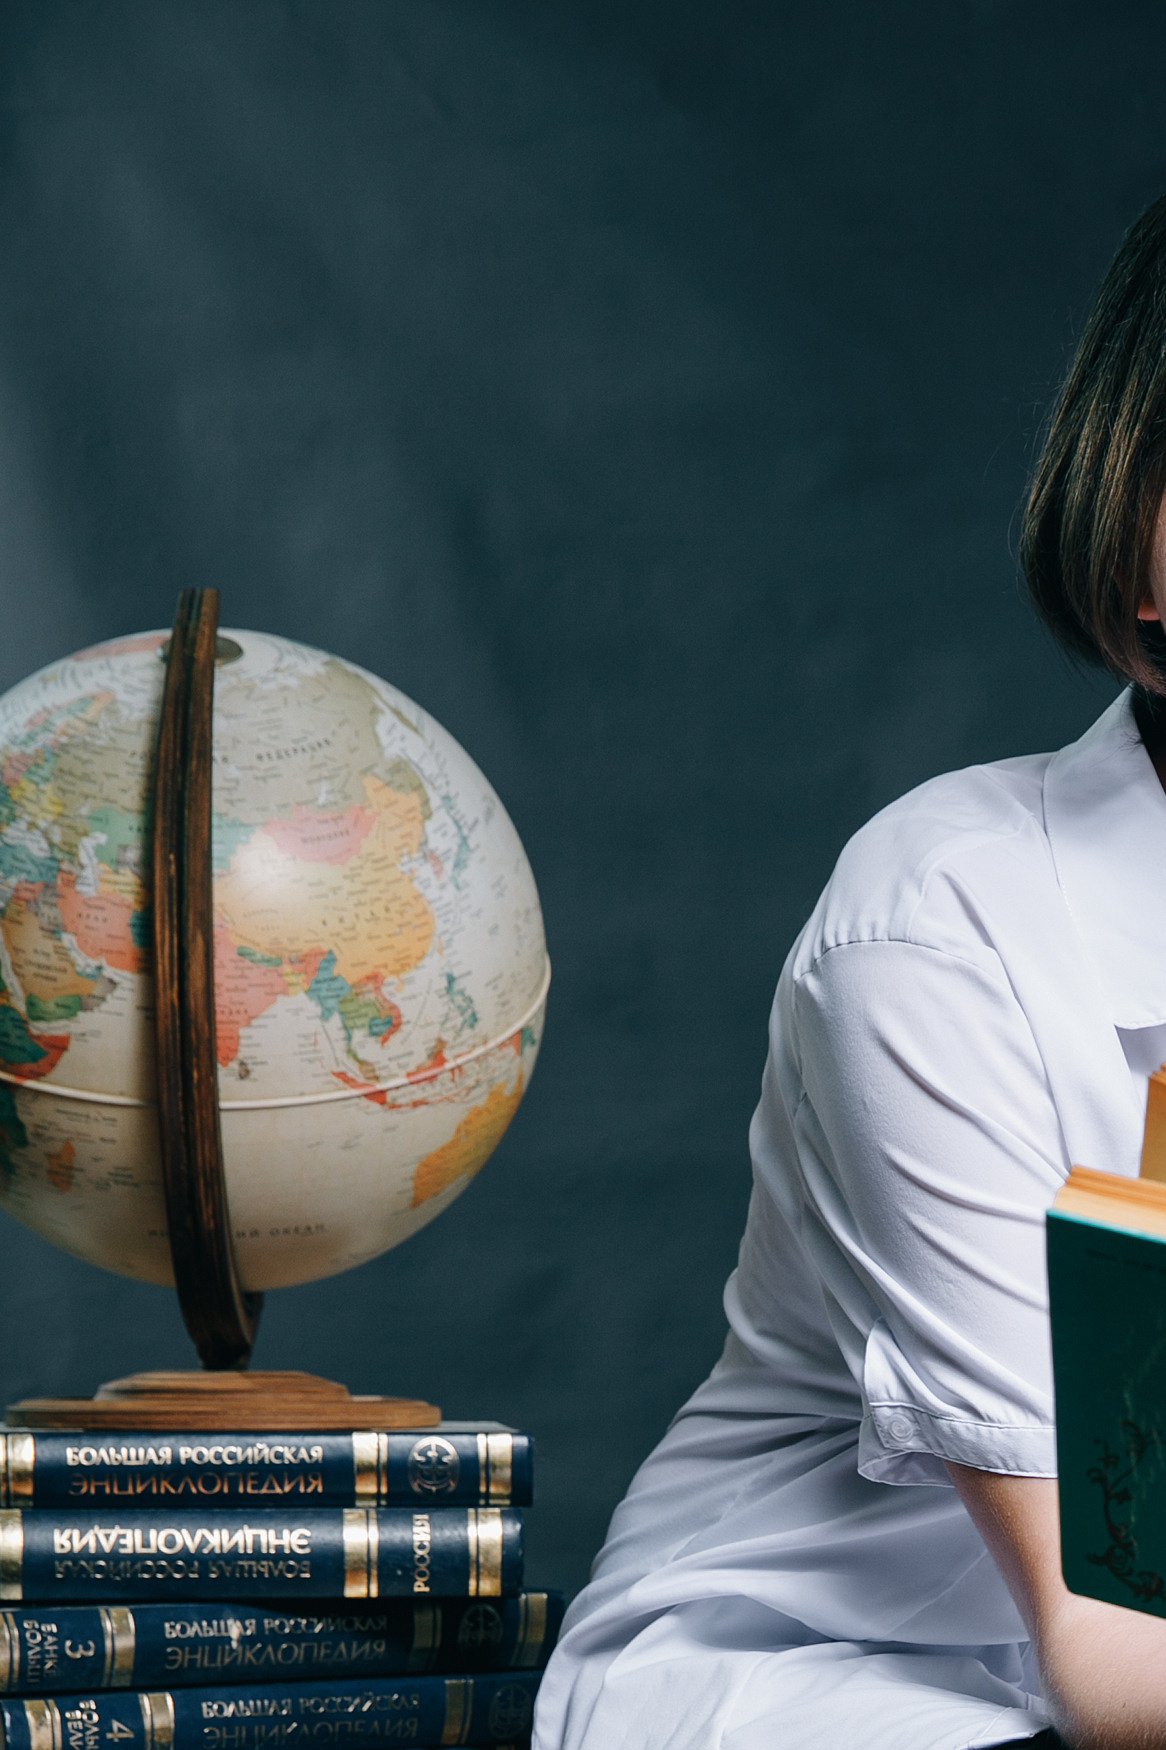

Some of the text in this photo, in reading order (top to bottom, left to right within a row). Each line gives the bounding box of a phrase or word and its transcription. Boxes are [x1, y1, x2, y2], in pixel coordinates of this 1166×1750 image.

[65, 1441, 324, 1467] БОЛЬШАЯ РОССИЙСКАЯ
[68, 1470, 324, 1496] ЭНЦИКЛОПЕДИЯ
[53, 1524, 312, 1554] ЭНЦИКЛОПЕДИЯ
[54, 1559, 312, 1581] БОЛЬШАЯ РОССИЙСКАЯ
[163, 1617, 257, 1640] БОЛЬШАЯ
[64, 1639, 96, 1660] 3
[164, 1639, 387, 1671] ЭНЦИКЛОПЕДИЯ
[200, 1690, 420, 1719] БОЛЬШАЯ РОССИЙСКАЯ
[105, 1718, 136, 1743] 4
[202, 1717, 419, 1750] ЭНЦИКЛОПЕДИЯ
